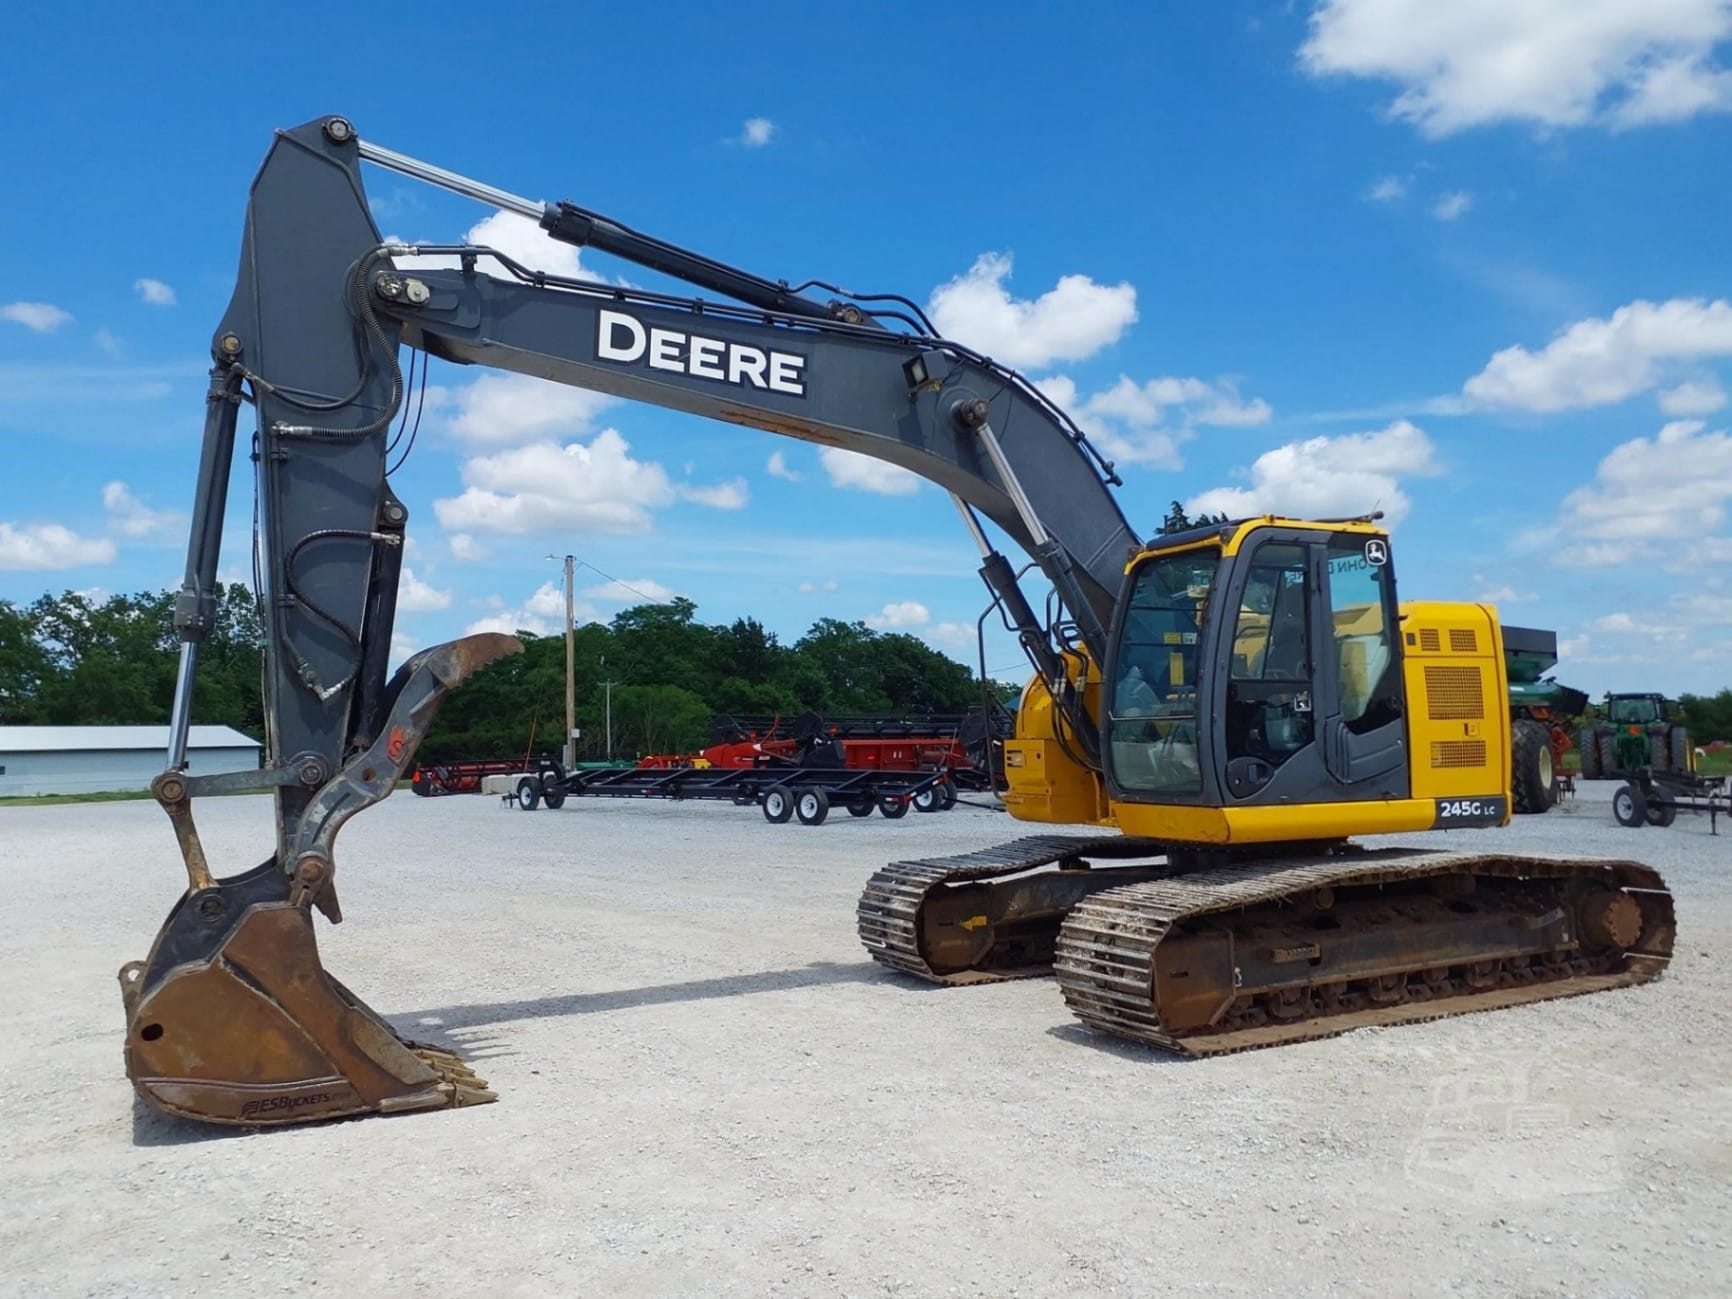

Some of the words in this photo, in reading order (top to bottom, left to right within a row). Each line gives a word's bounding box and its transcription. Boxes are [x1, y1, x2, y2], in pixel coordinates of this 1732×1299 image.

[598, 309, 804, 395] DEERE
[1440, 801, 1481, 818] 245G
[1484, 806, 1496, 816] LC
